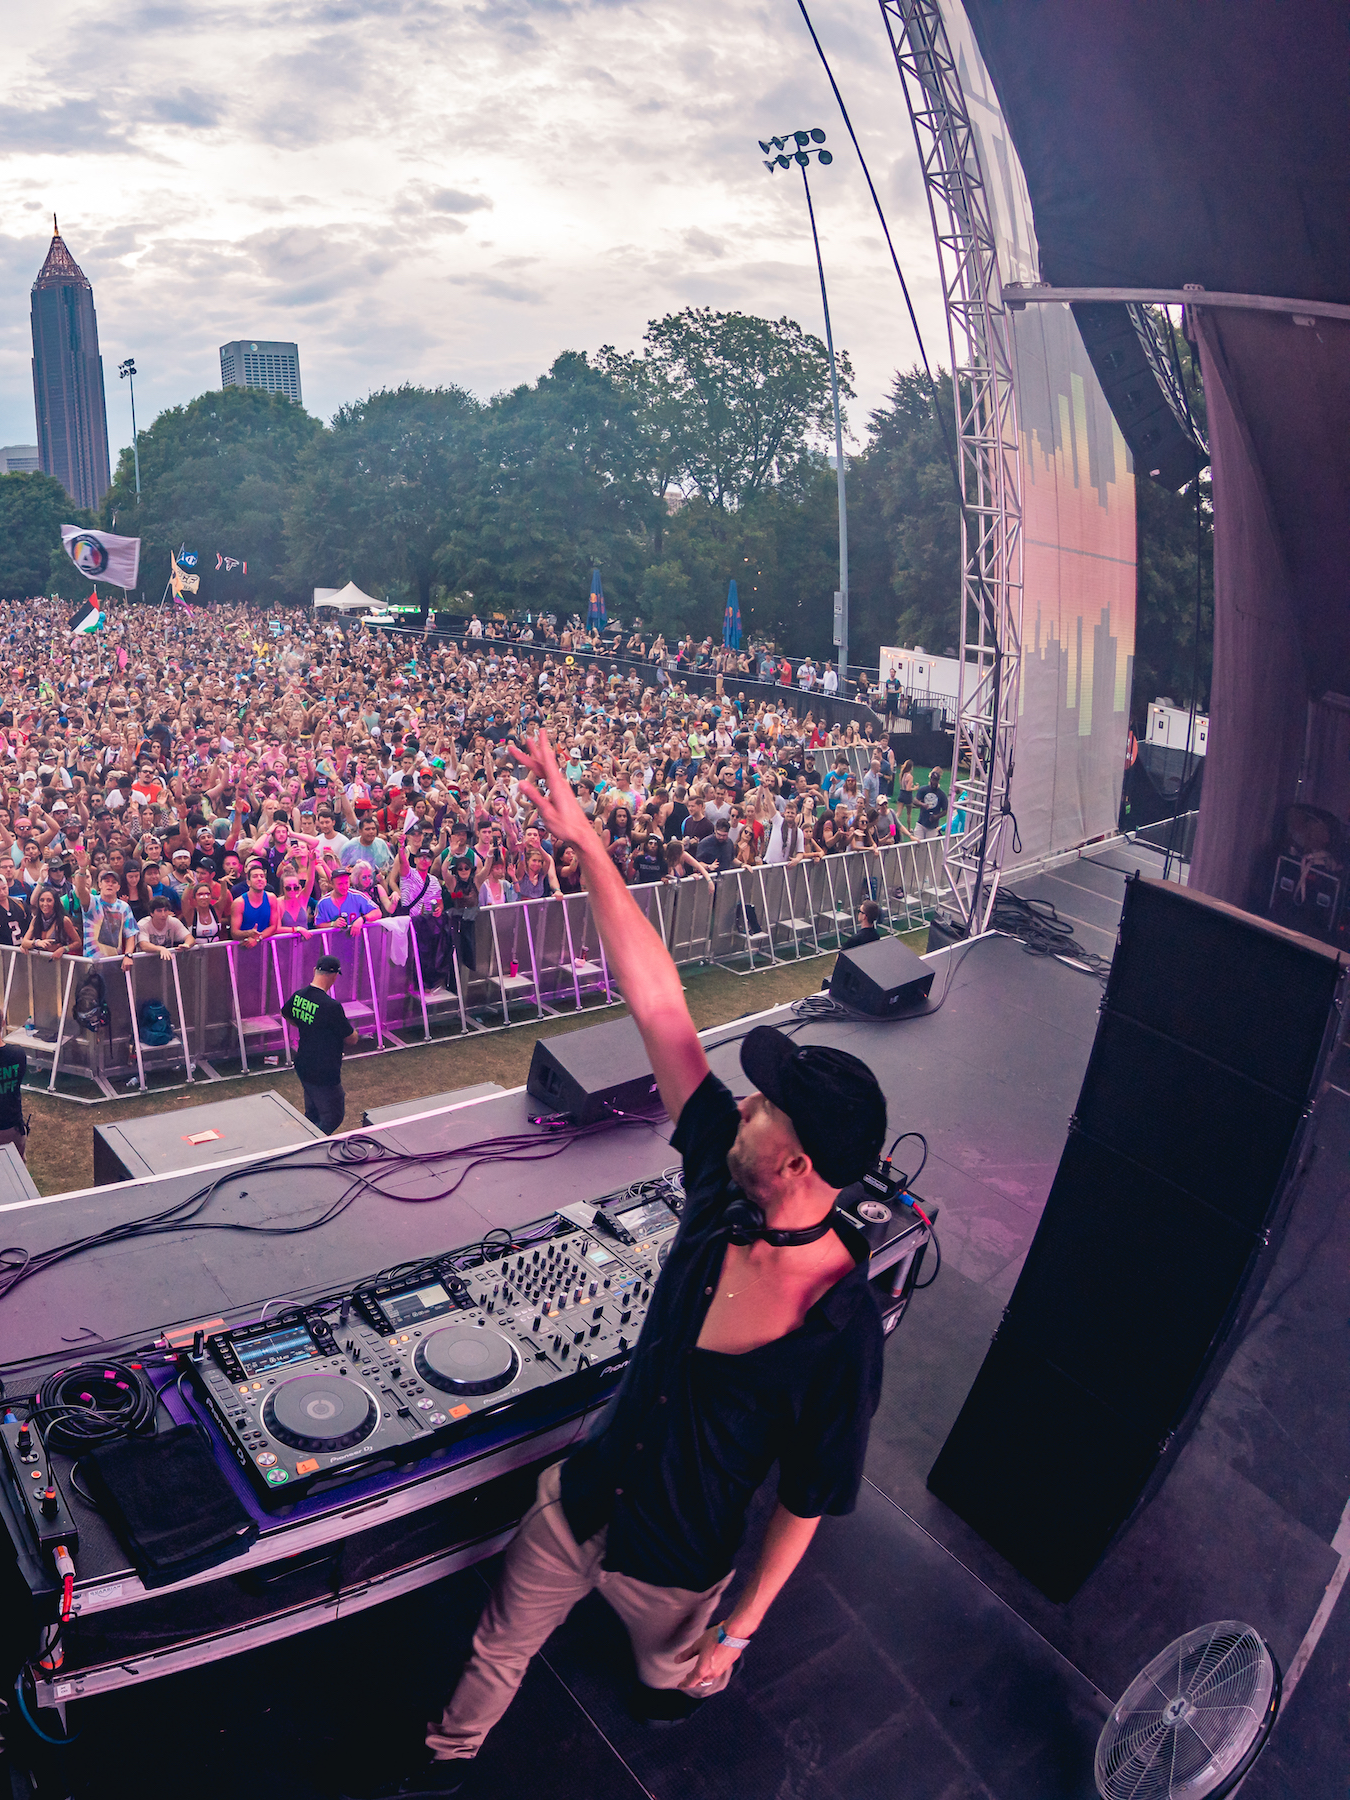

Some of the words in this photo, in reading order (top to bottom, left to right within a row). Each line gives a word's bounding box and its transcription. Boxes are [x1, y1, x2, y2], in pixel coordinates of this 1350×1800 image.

[8, 921, 23, 945] 2
[293, 994, 320, 1015] EVENT
[292, 1006, 315, 1025] STAFF
[206, 1397, 236, 1446] Pioneer
[330, 1449, 362, 1463] Pioneer
[90, 1585, 121, 1596] GUARDIAN
